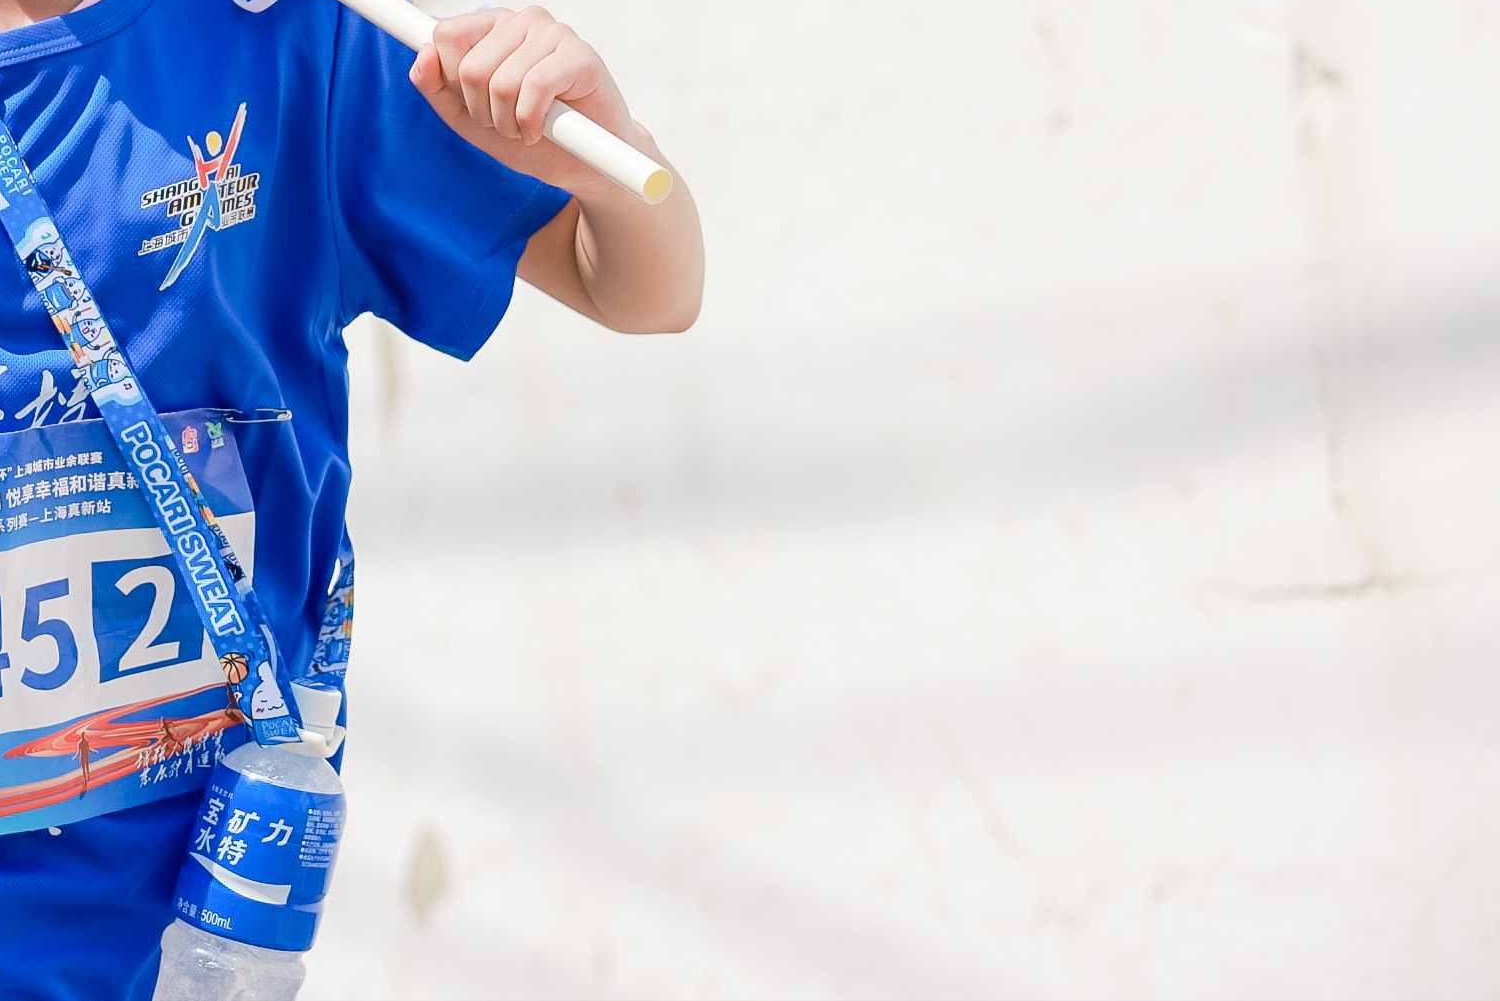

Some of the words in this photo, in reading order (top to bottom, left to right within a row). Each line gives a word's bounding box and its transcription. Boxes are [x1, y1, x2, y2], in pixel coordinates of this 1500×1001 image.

[138, 227, 190, 256] 上海城市
[120, 420, 197, 535] POCARI
[177, 531, 245, 636] SWEAT
[263, 727, 295, 738] SWEA
[203, 798, 293, 847] 宝矿力
[195, 826, 248, 865] 水特
